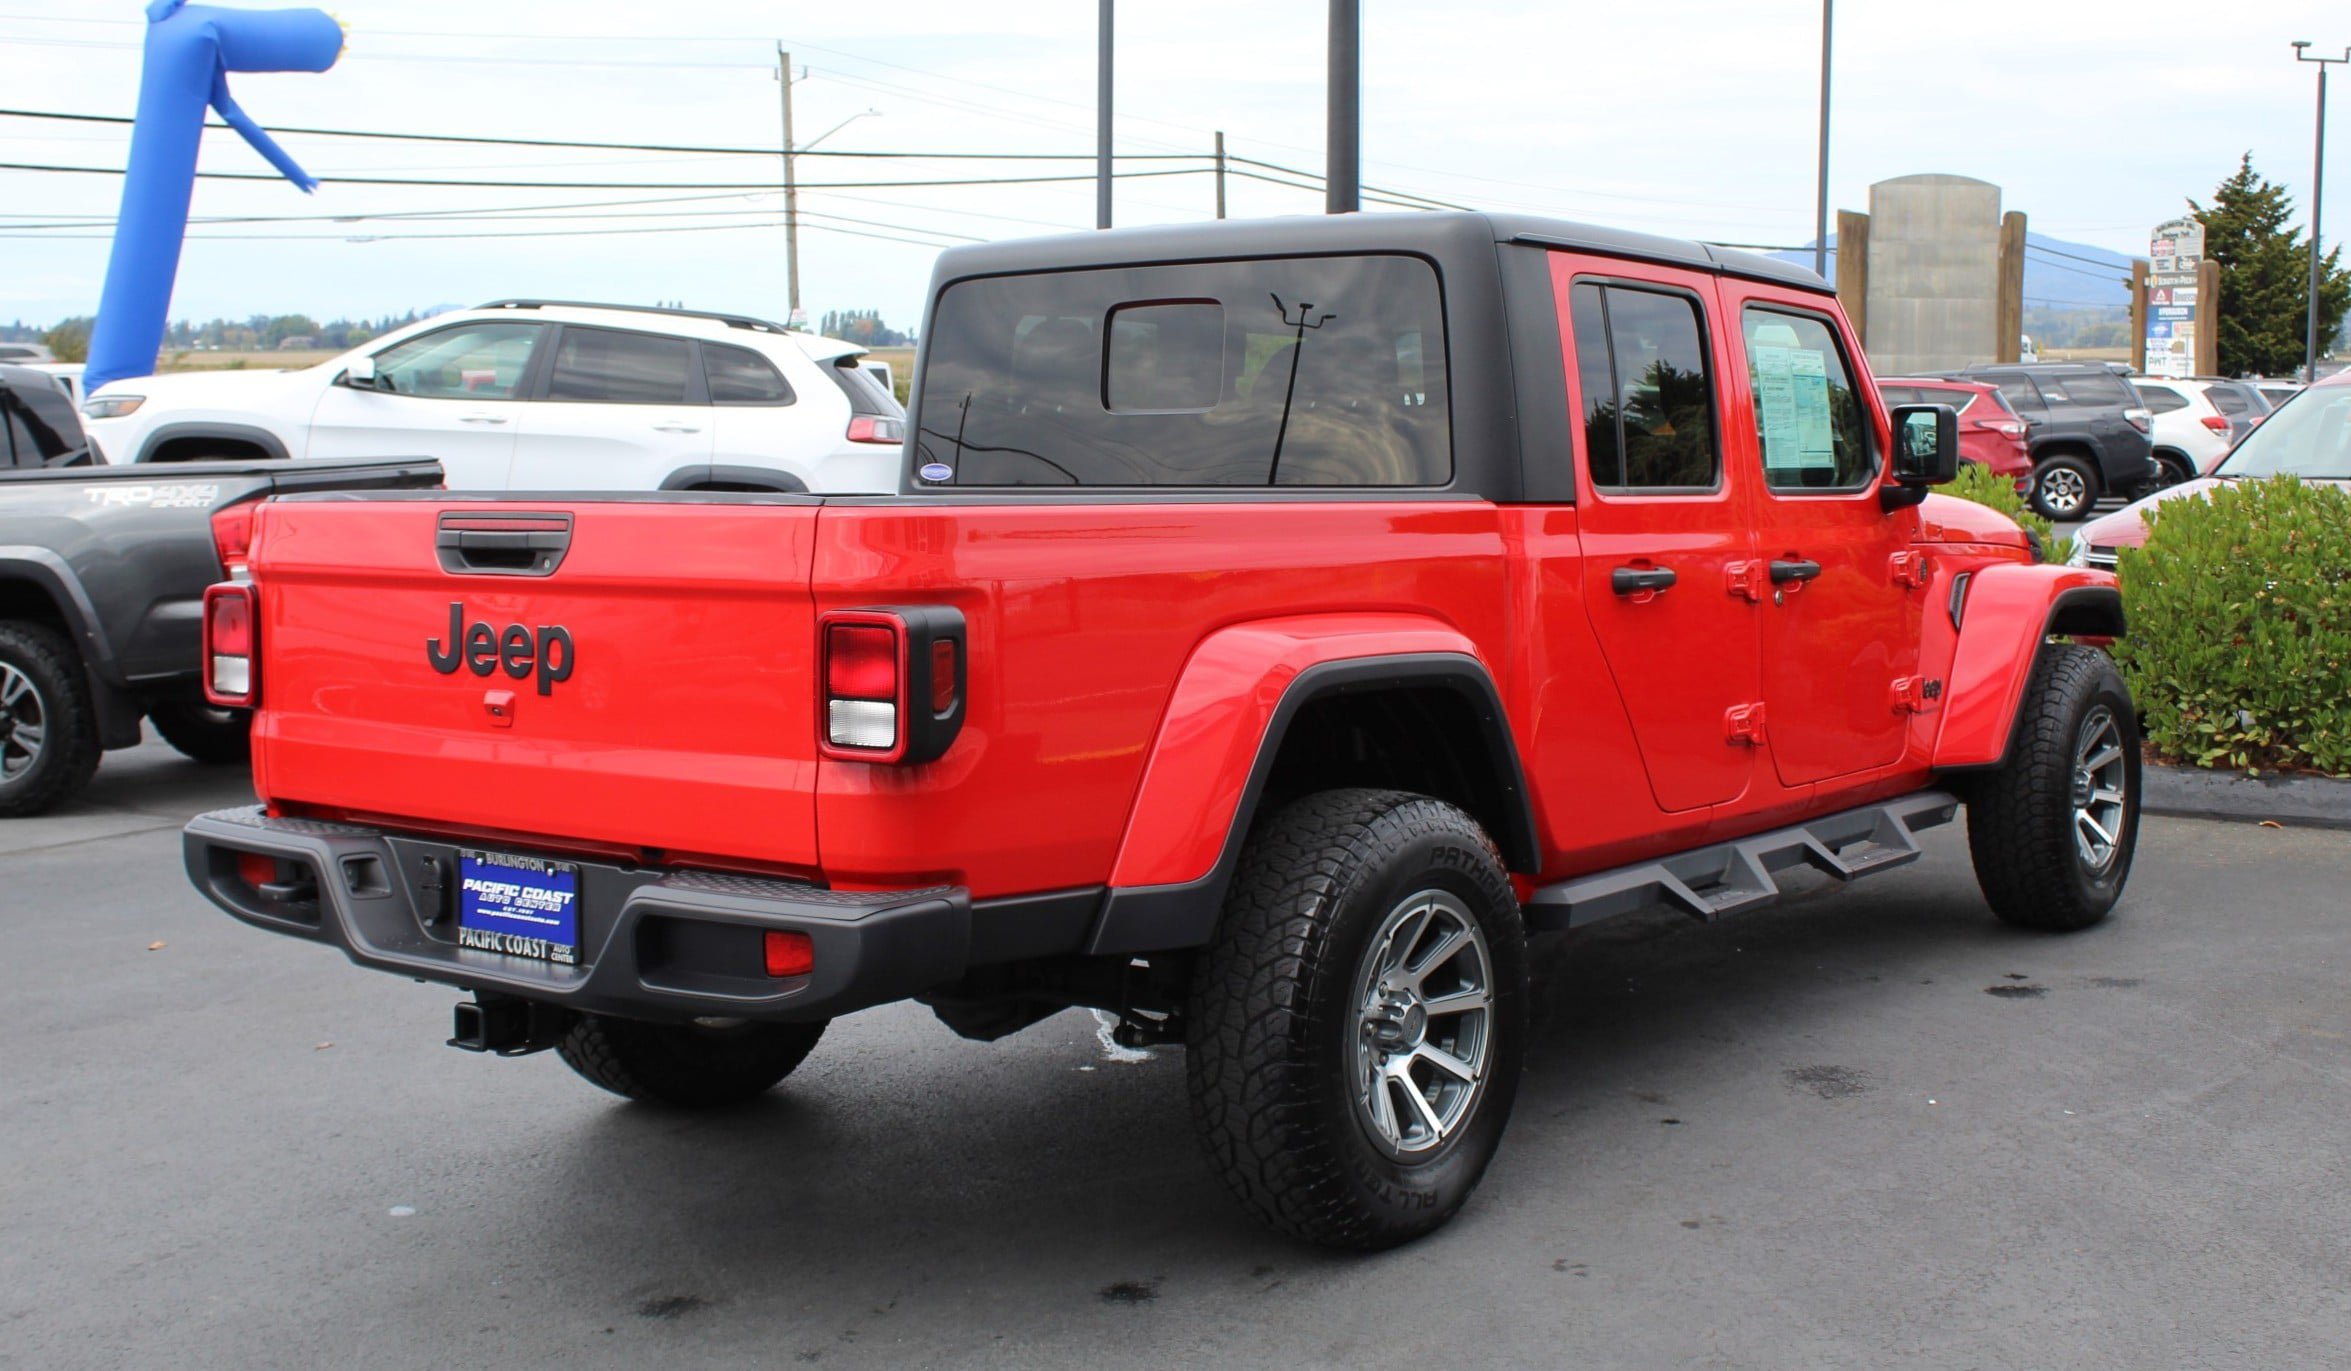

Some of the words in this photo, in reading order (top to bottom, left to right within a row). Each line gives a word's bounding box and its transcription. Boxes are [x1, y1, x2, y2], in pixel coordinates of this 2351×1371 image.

[427, 601, 575, 697] Jeep
[485, 852, 545, 872] BURLINGTON
[463, 878, 520, 897] PACIFIC
[522, 886, 574, 905] COAST
[479, 892, 511, 905] AUTO
[514, 897, 562, 912] CENTER
[458, 926, 502, 952] PACIFIC
[505, 934, 547, 959] COAST
[553, 944, 571, 953] AUTO
[551, 953, 574, 964] CENTER
